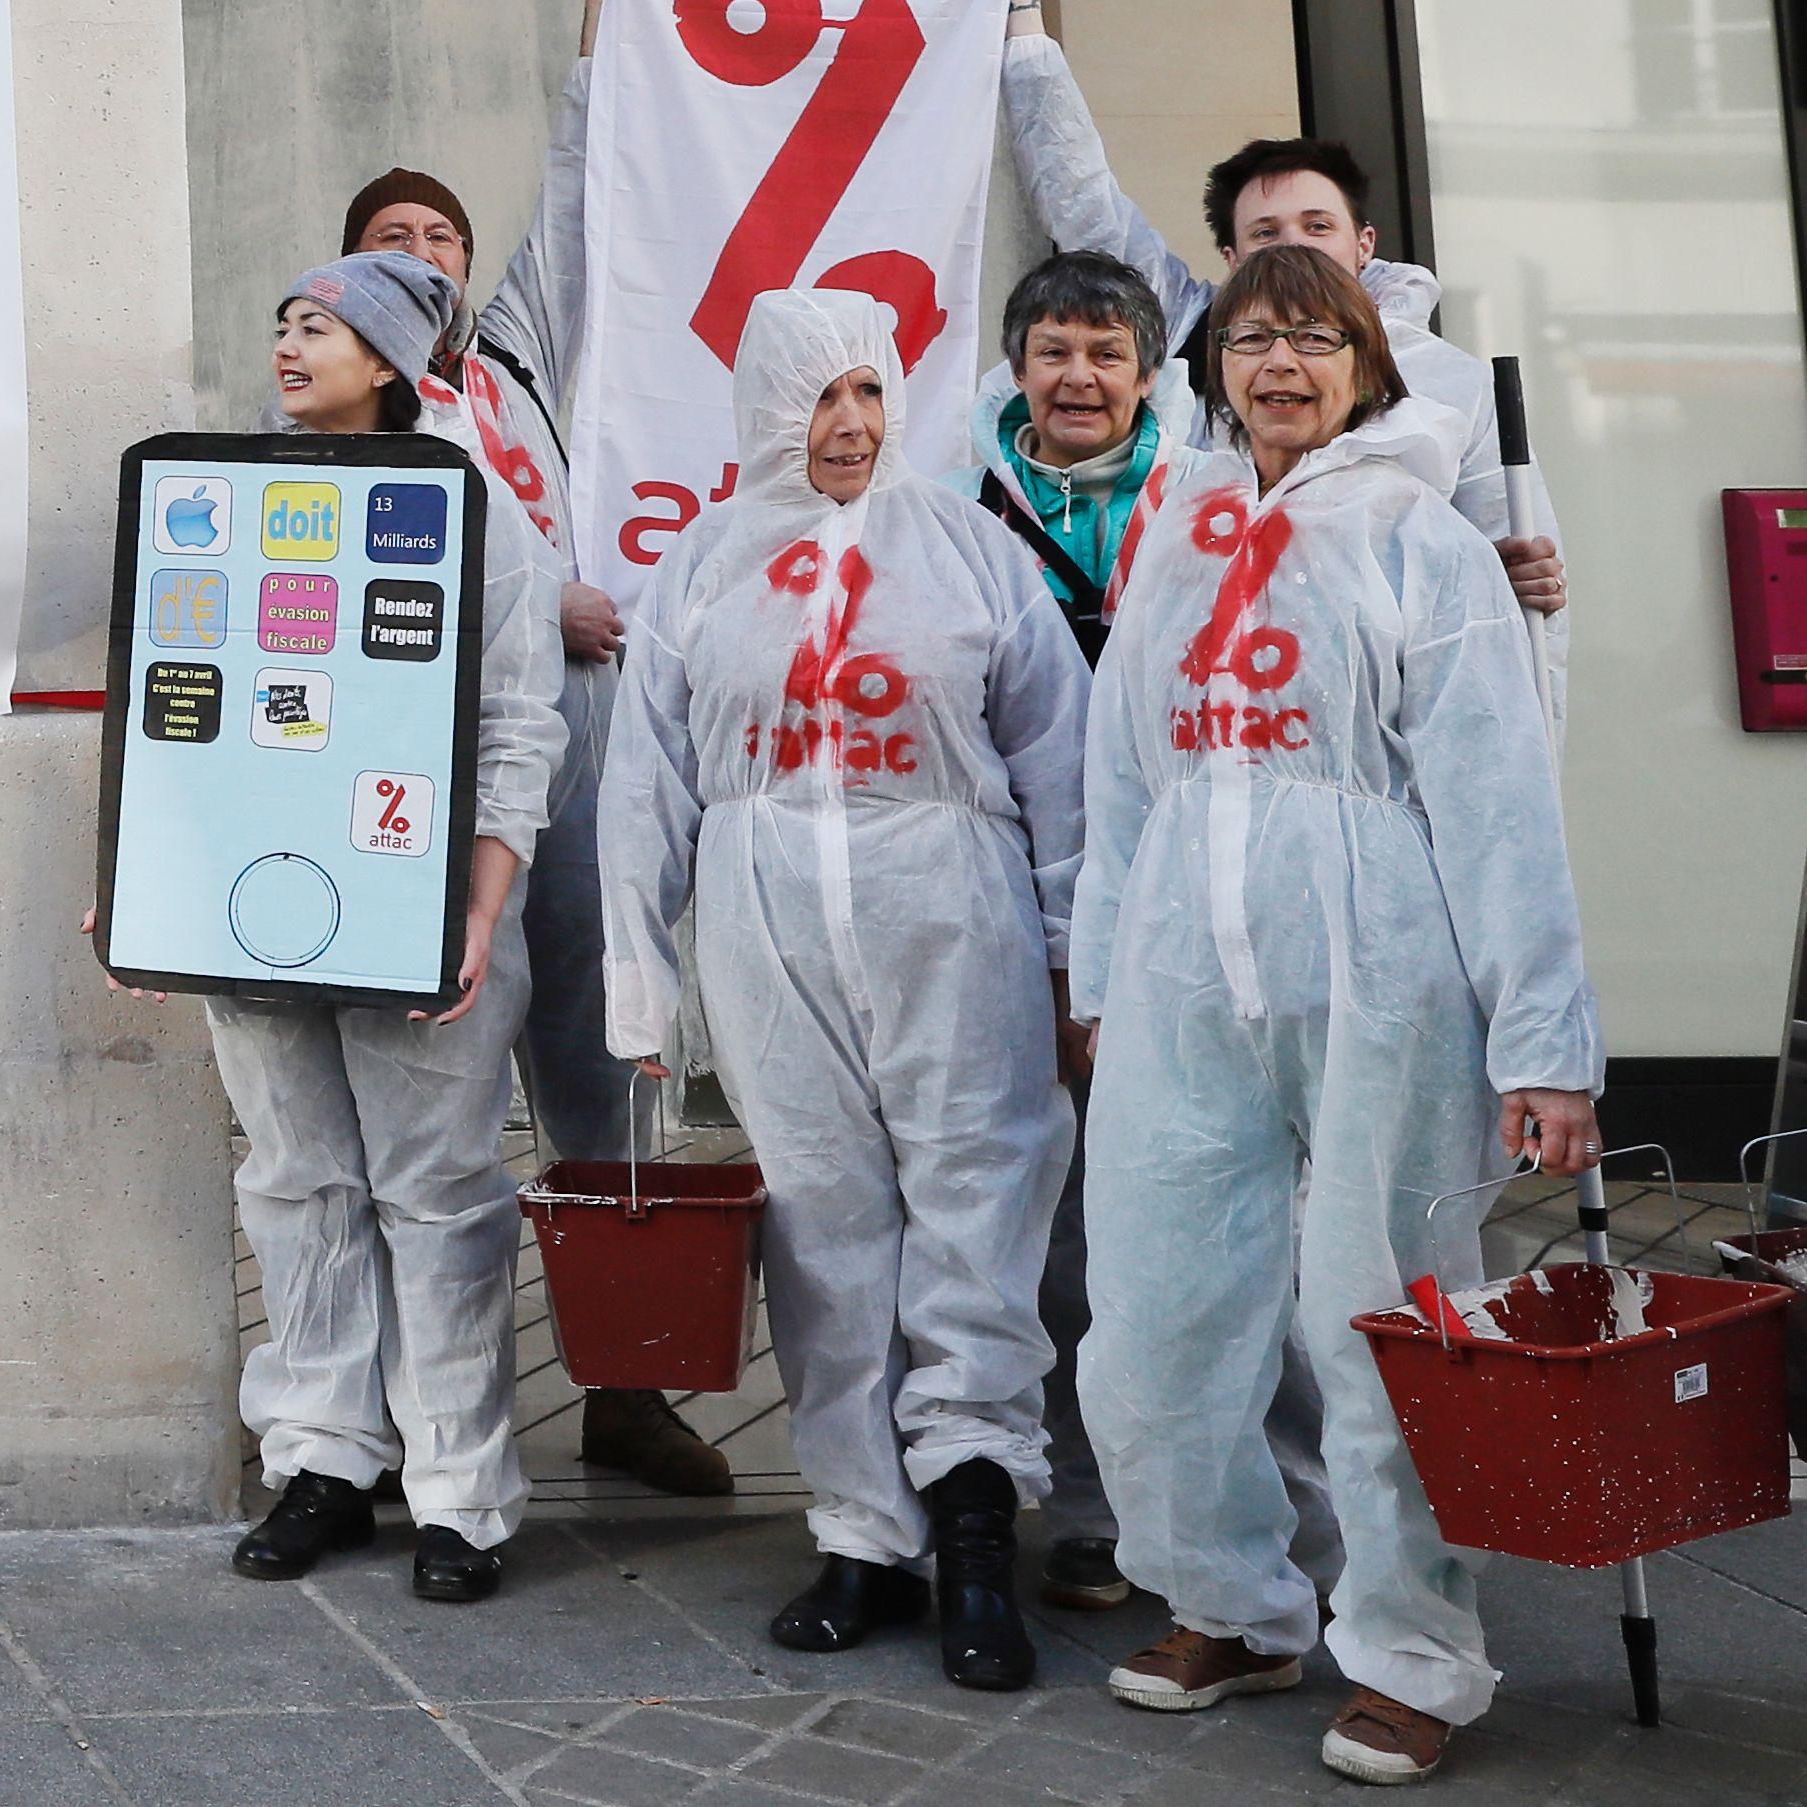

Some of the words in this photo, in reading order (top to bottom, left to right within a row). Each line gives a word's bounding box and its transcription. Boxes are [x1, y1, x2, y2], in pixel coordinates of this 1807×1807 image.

[374, 496, 394, 513] 13
[267, 499, 335, 542] doit
[372, 532, 438, 550] Milliards
[269, 577, 331, 594] pour
[157, 575, 220, 644] d'€
[268, 603, 330, 623] évasion
[374, 596, 434, 619] Rendez
[266, 631, 328, 651] fiscale
[370, 624, 434, 646] l'argent
[369, 832, 413, 850] attac
